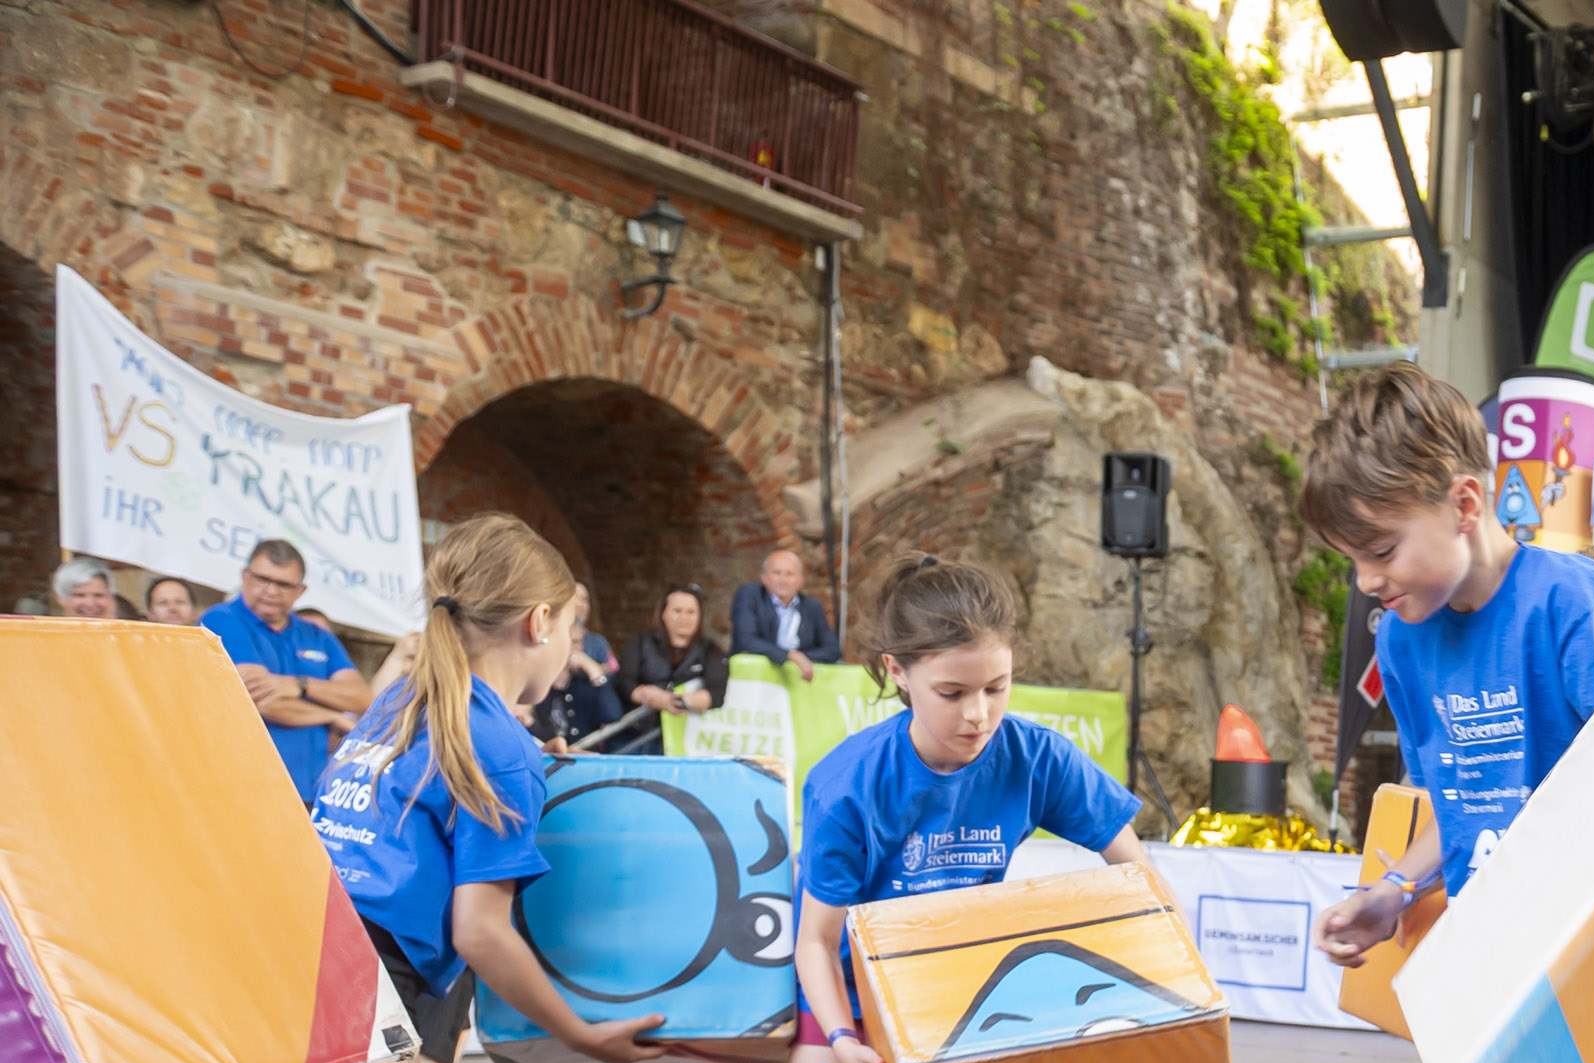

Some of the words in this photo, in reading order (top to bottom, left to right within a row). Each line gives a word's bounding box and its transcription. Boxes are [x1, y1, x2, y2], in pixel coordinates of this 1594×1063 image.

[93, 385, 178, 467] VS
[1501, 403, 1536, 458] S
[1451, 693, 1480, 713] Das
[1481, 685, 1518, 709] Land
[1452, 715, 1524, 741] Steiermark
[696, 731, 784, 757] NETZE
[960, 825, 1001, 841] Land
[926, 848, 1002, 866] Steiermark
